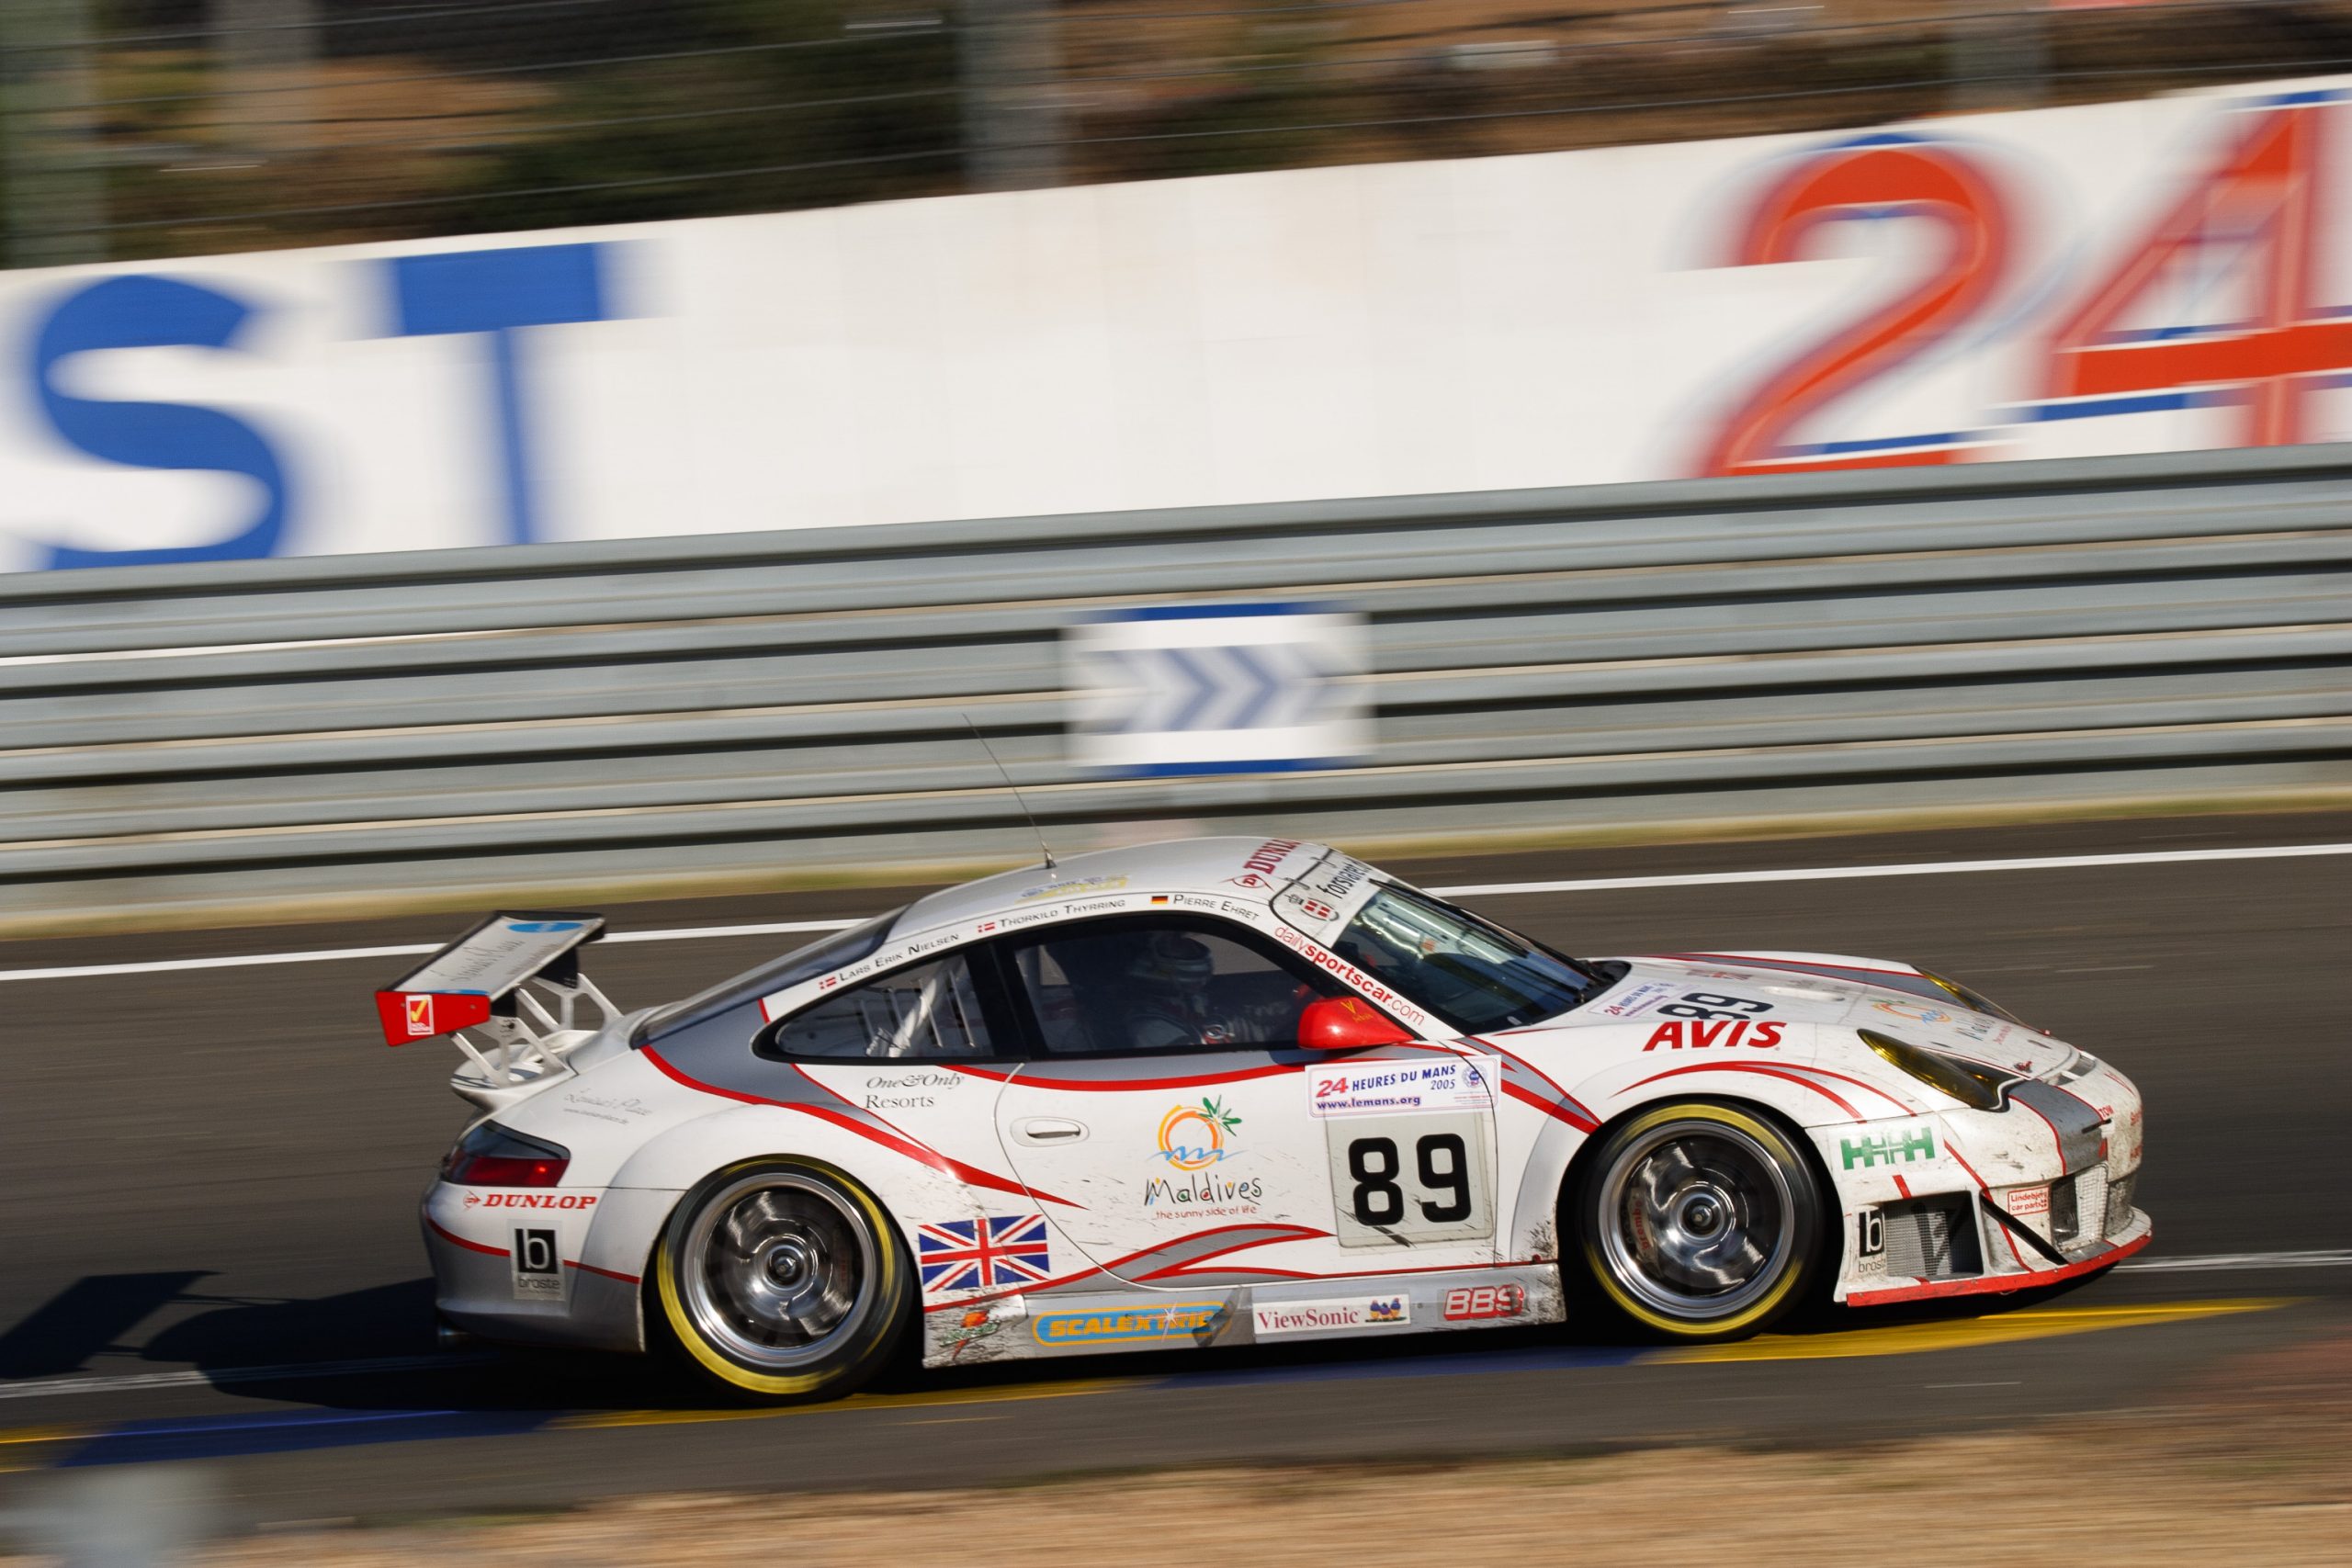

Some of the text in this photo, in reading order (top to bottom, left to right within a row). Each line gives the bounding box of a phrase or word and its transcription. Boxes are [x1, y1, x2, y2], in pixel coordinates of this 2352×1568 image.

[1700, 89, 2352, 478] 24
[23, 241, 634, 570] ST
[1243, 840, 1303, 874] DUNL
[1001, 899, 1125, 927] THORKILD THYRRING
[1173, 895, 1259, 920] PIERRE EHRET
[839, 934, 959, 982] LARS ERIK NIELSEN
[1274, 926, 1425, 1026] dailysportscar.com
[1642, 1021, 1787, 1052] AVIS
[1316, 1065, 1456, 1098] 24 HEURES DU MANS
[1430, 1078, 1456, 1090] 2005
[866, 1094, 934, 1108] Resorts
[1317, 1095, 1420, 1111] www.lemans.org
[1144, 1172, 1262, 1206] Maldives
[1349, 1133, 1471, 1226] 89
[482, 1194, 597, 1209] DUNLOP
[1174, 1210, 1204, 1219] sunny
[1205, 1207, 1227, 1216] side
[1228, 1206, 1239, 1215] of
[1241, 1204, 1257, 1214] life
[518, 1276, 560, 1291] broste
[1446, 1286, 1521, 1315] BBS
[1258, 1307, 1360, 1328] ViewSonic
